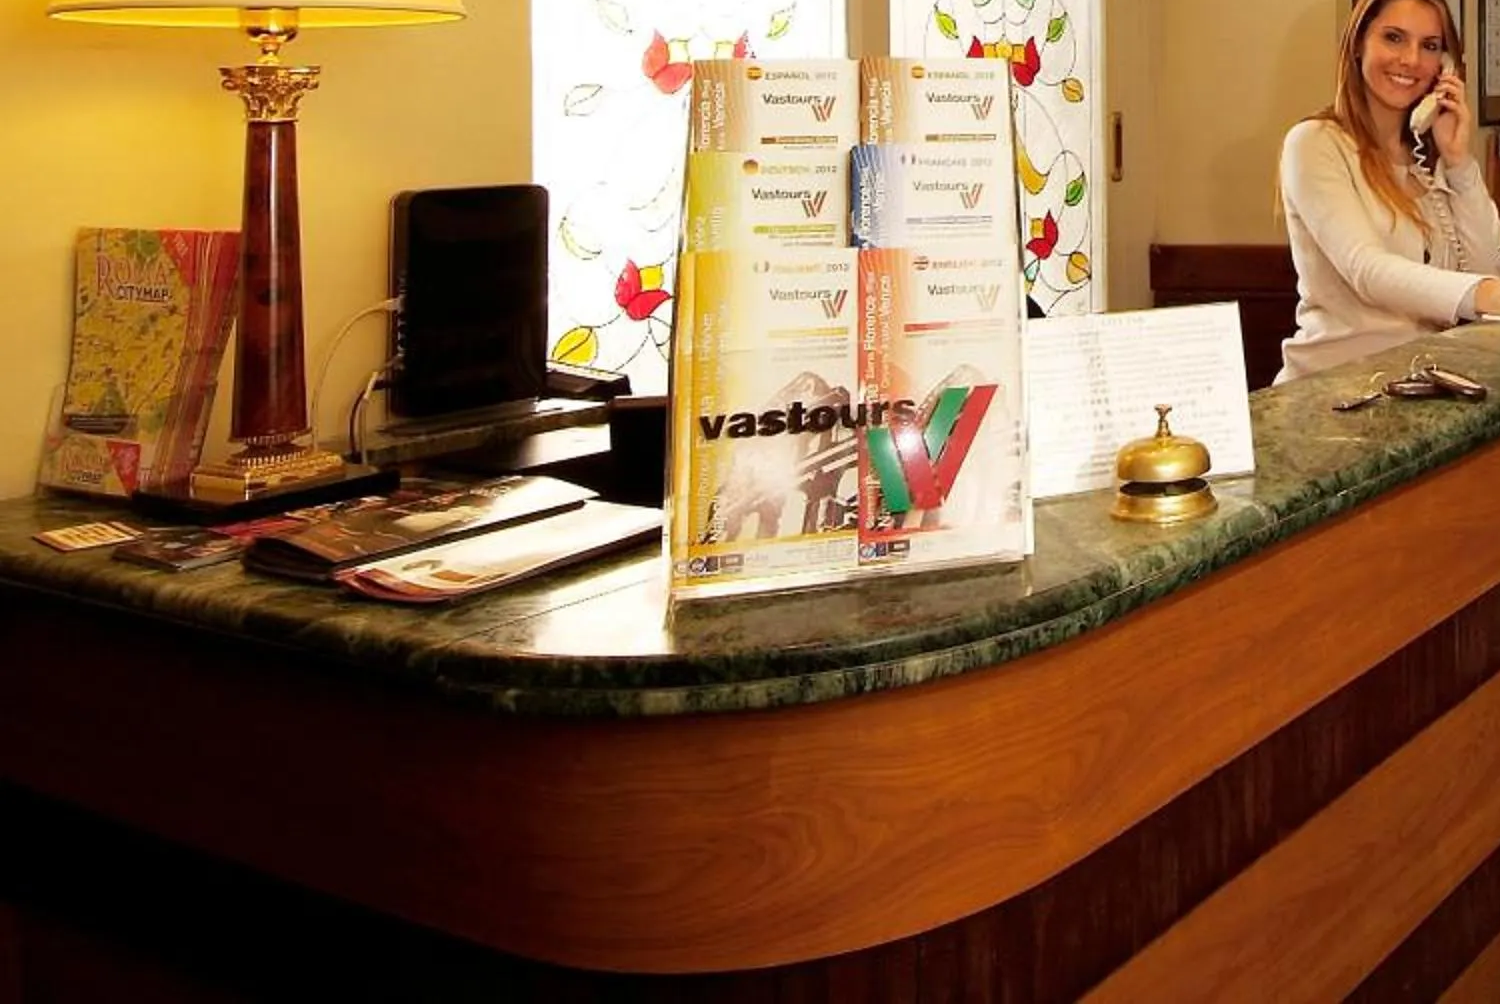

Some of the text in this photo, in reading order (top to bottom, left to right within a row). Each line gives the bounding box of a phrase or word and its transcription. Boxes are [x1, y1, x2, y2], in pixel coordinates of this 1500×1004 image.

[762, 92, 823, 106] Vastours
[925, 91, 982, 104] Vastours
[815, 164, 838, 175] 2012
[912, 180, 969, 192] Vastours
[751, 187, 812, 200] Vastours
[768, 288, 833, 301] Vastours
[699, 399, 916, 441] vastours
